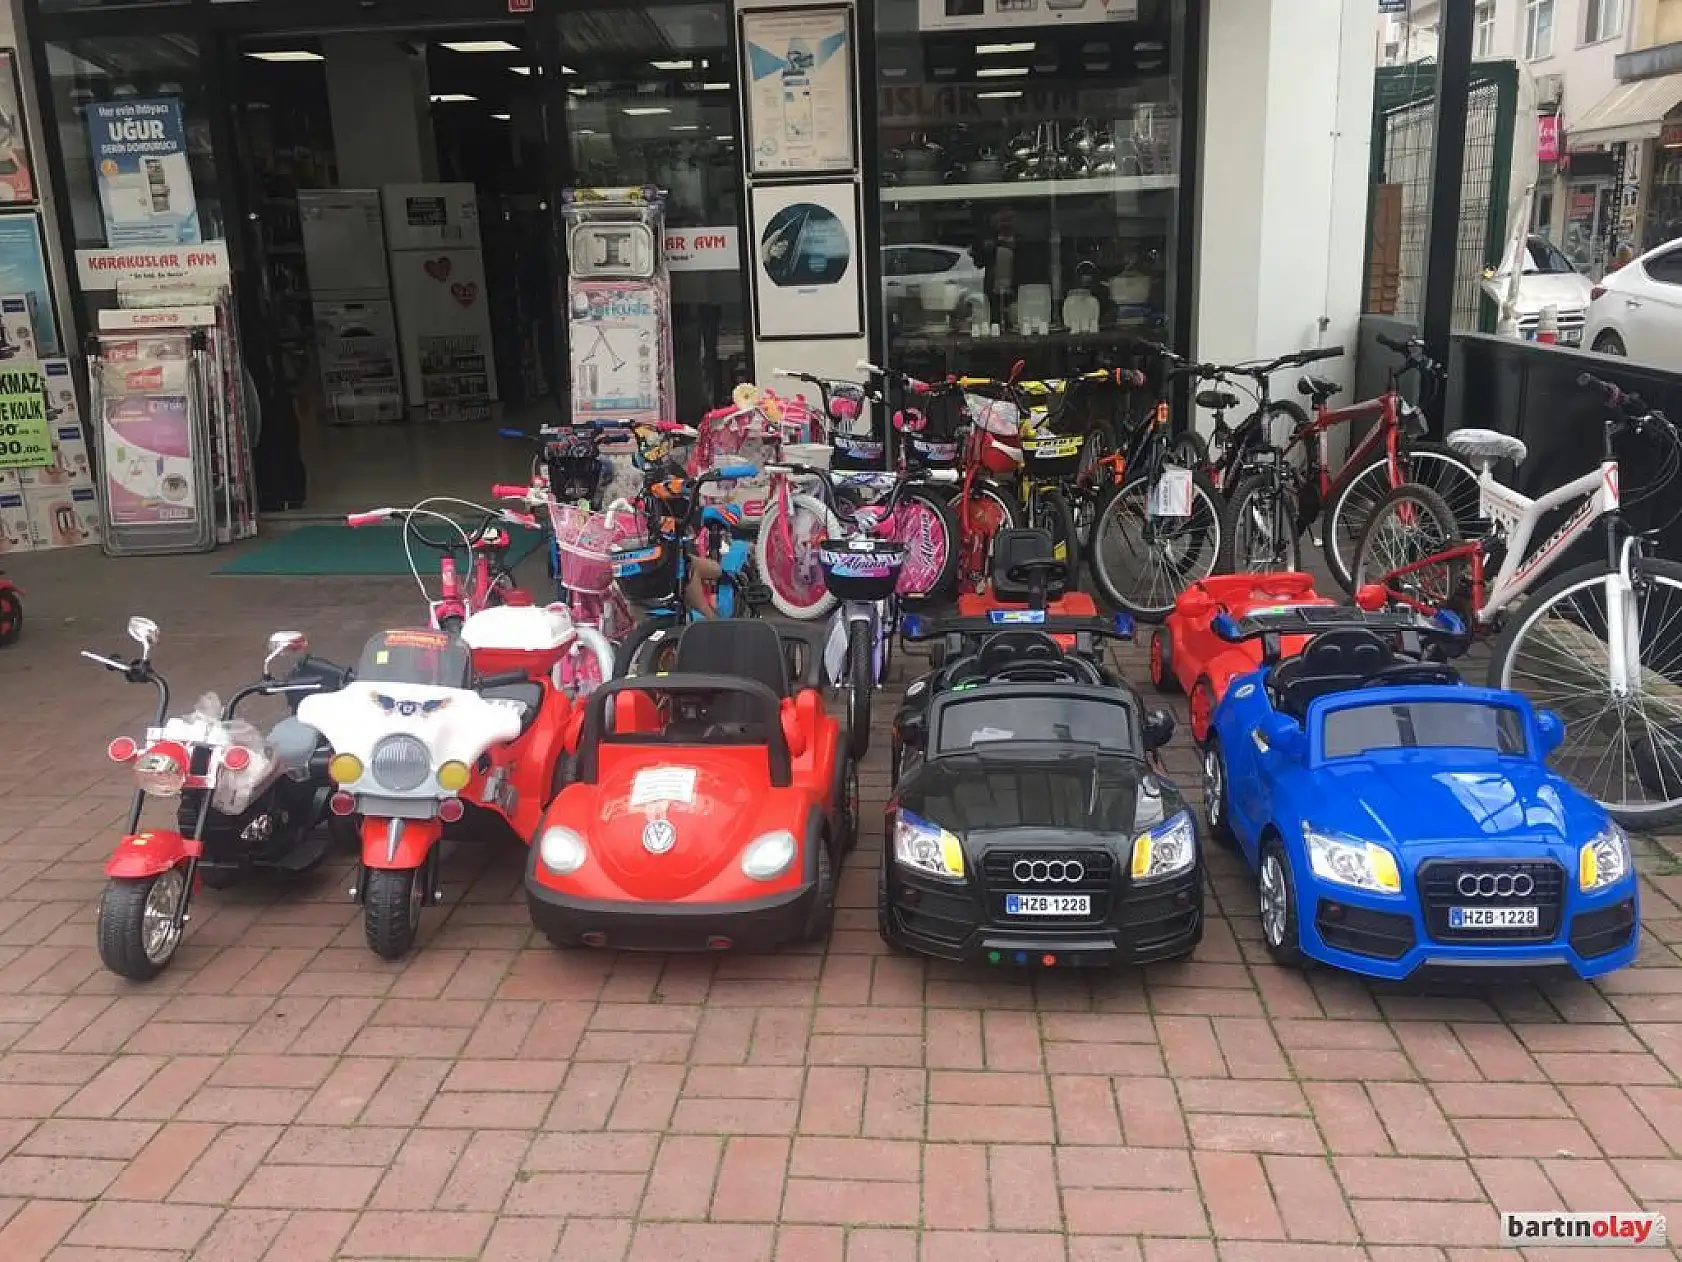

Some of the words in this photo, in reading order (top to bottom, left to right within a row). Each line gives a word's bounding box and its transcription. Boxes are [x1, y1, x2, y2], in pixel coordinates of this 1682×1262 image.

[108, 118, 166, 141] UĞUR
[694, 234, 726, 250] AVM
[187, 252, 217, 267] AVM
